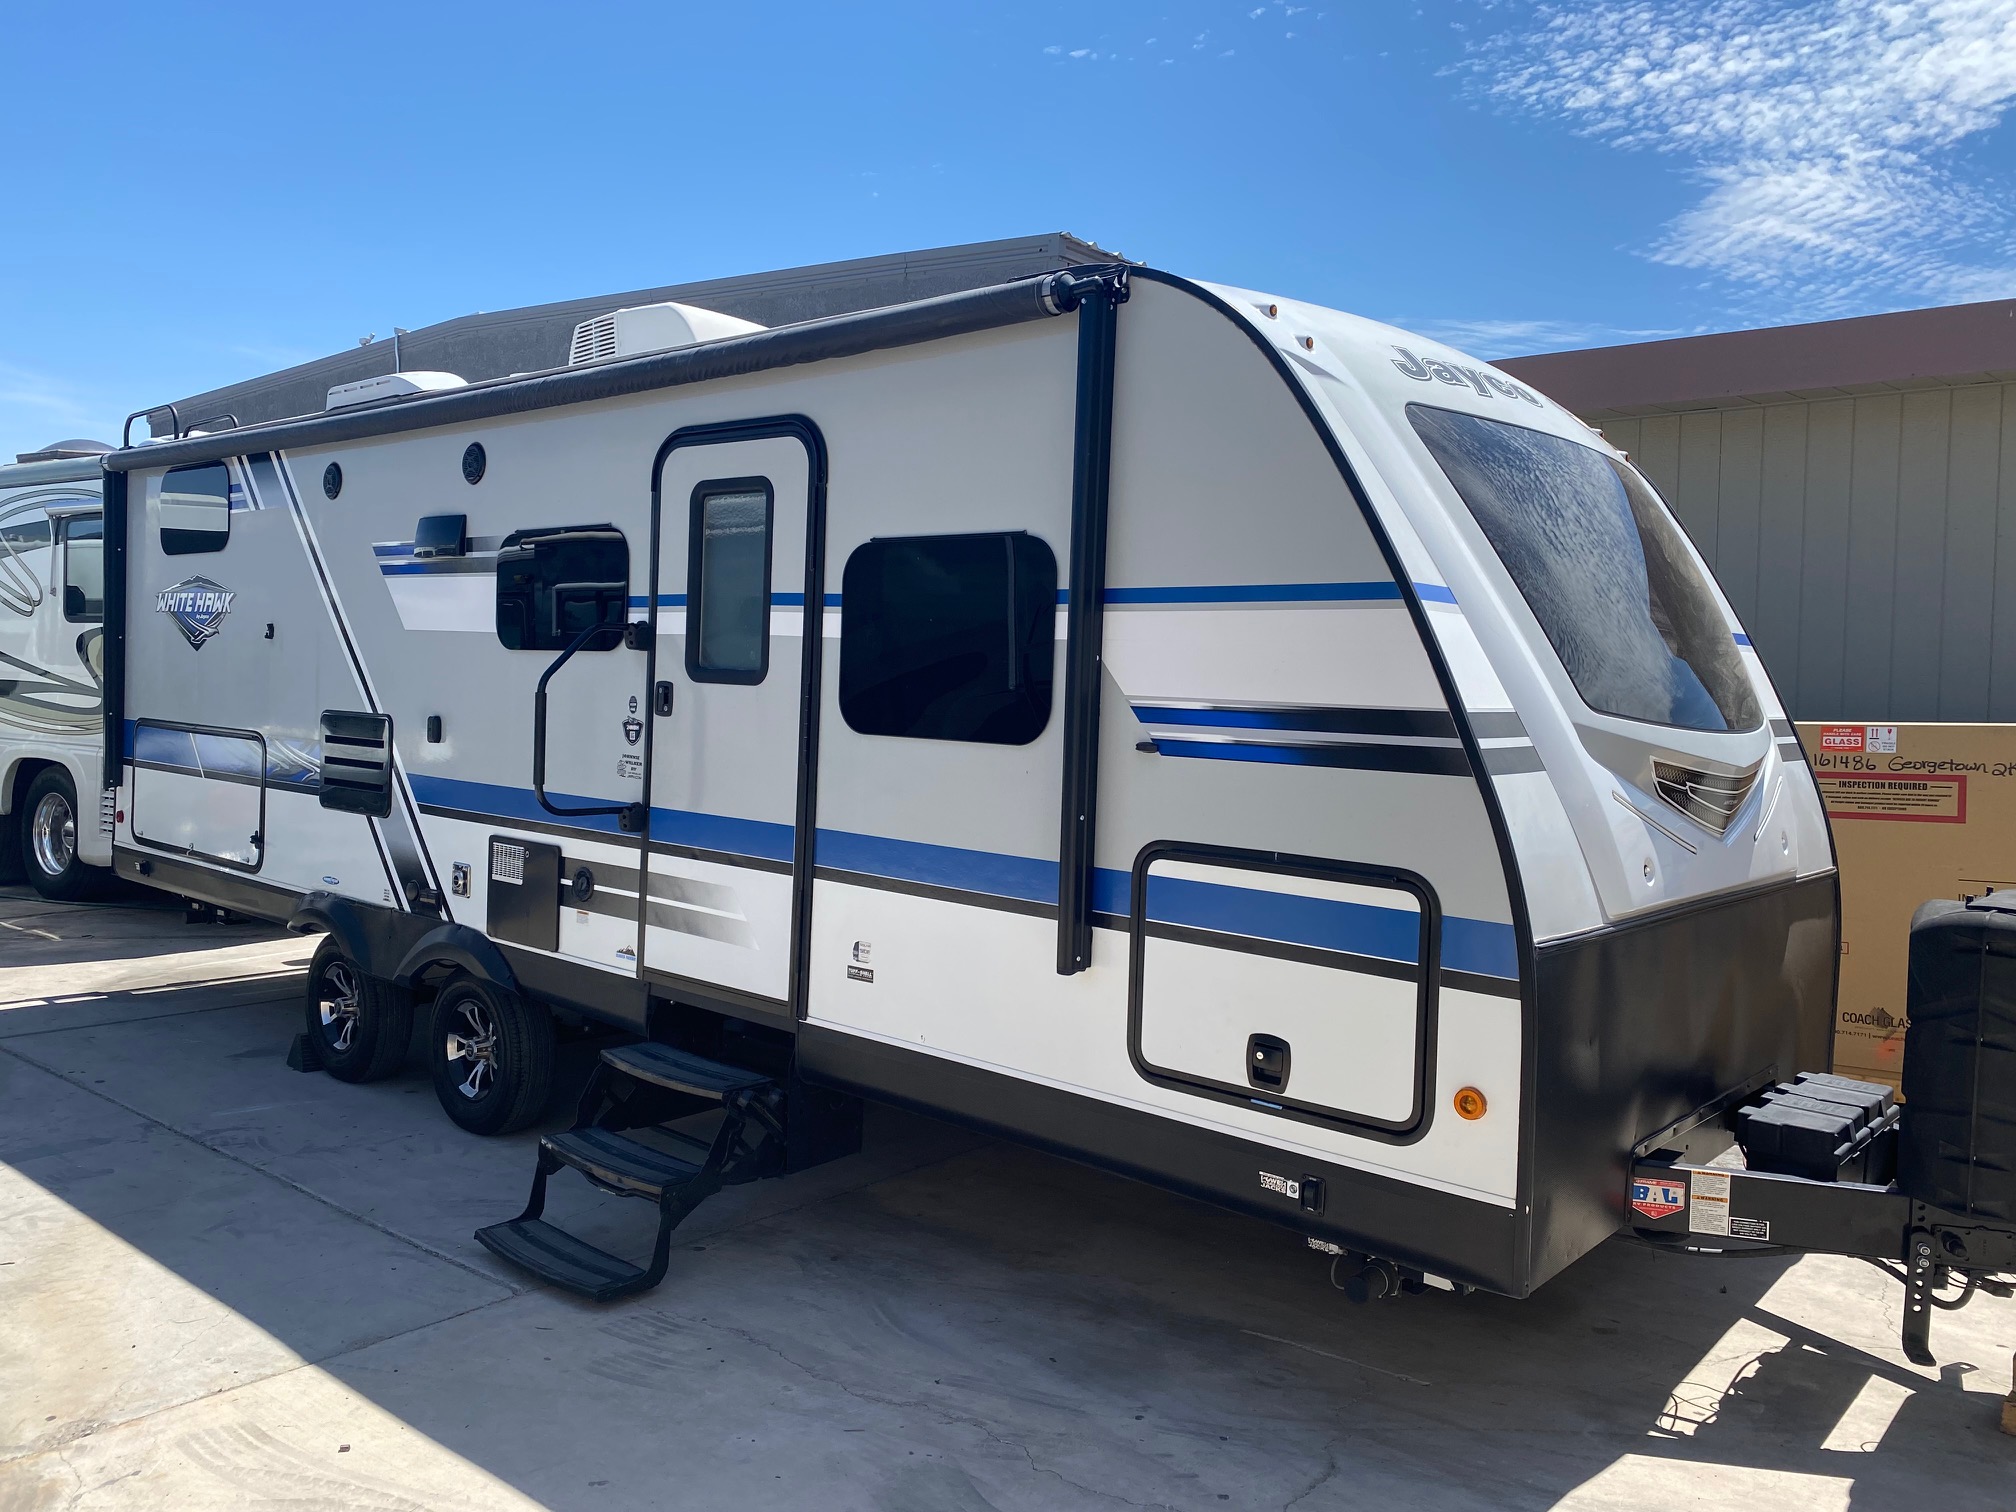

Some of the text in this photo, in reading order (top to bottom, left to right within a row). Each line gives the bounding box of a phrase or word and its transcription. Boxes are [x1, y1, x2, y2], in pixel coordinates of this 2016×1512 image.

[1391, 345, 1543, 408] Jayco
[156, 592, 235, 613] WHITE HAWK
[1814, 753, 1876, 770] 161486
[1888, 756, 1988, 773] Georgetown
[1838, 780, 1928, 791] INSPECTION REQUIRED
[1842, 1012, 1880, 1026] COACH
[1633, 1185, 1678, 1204] BAL
